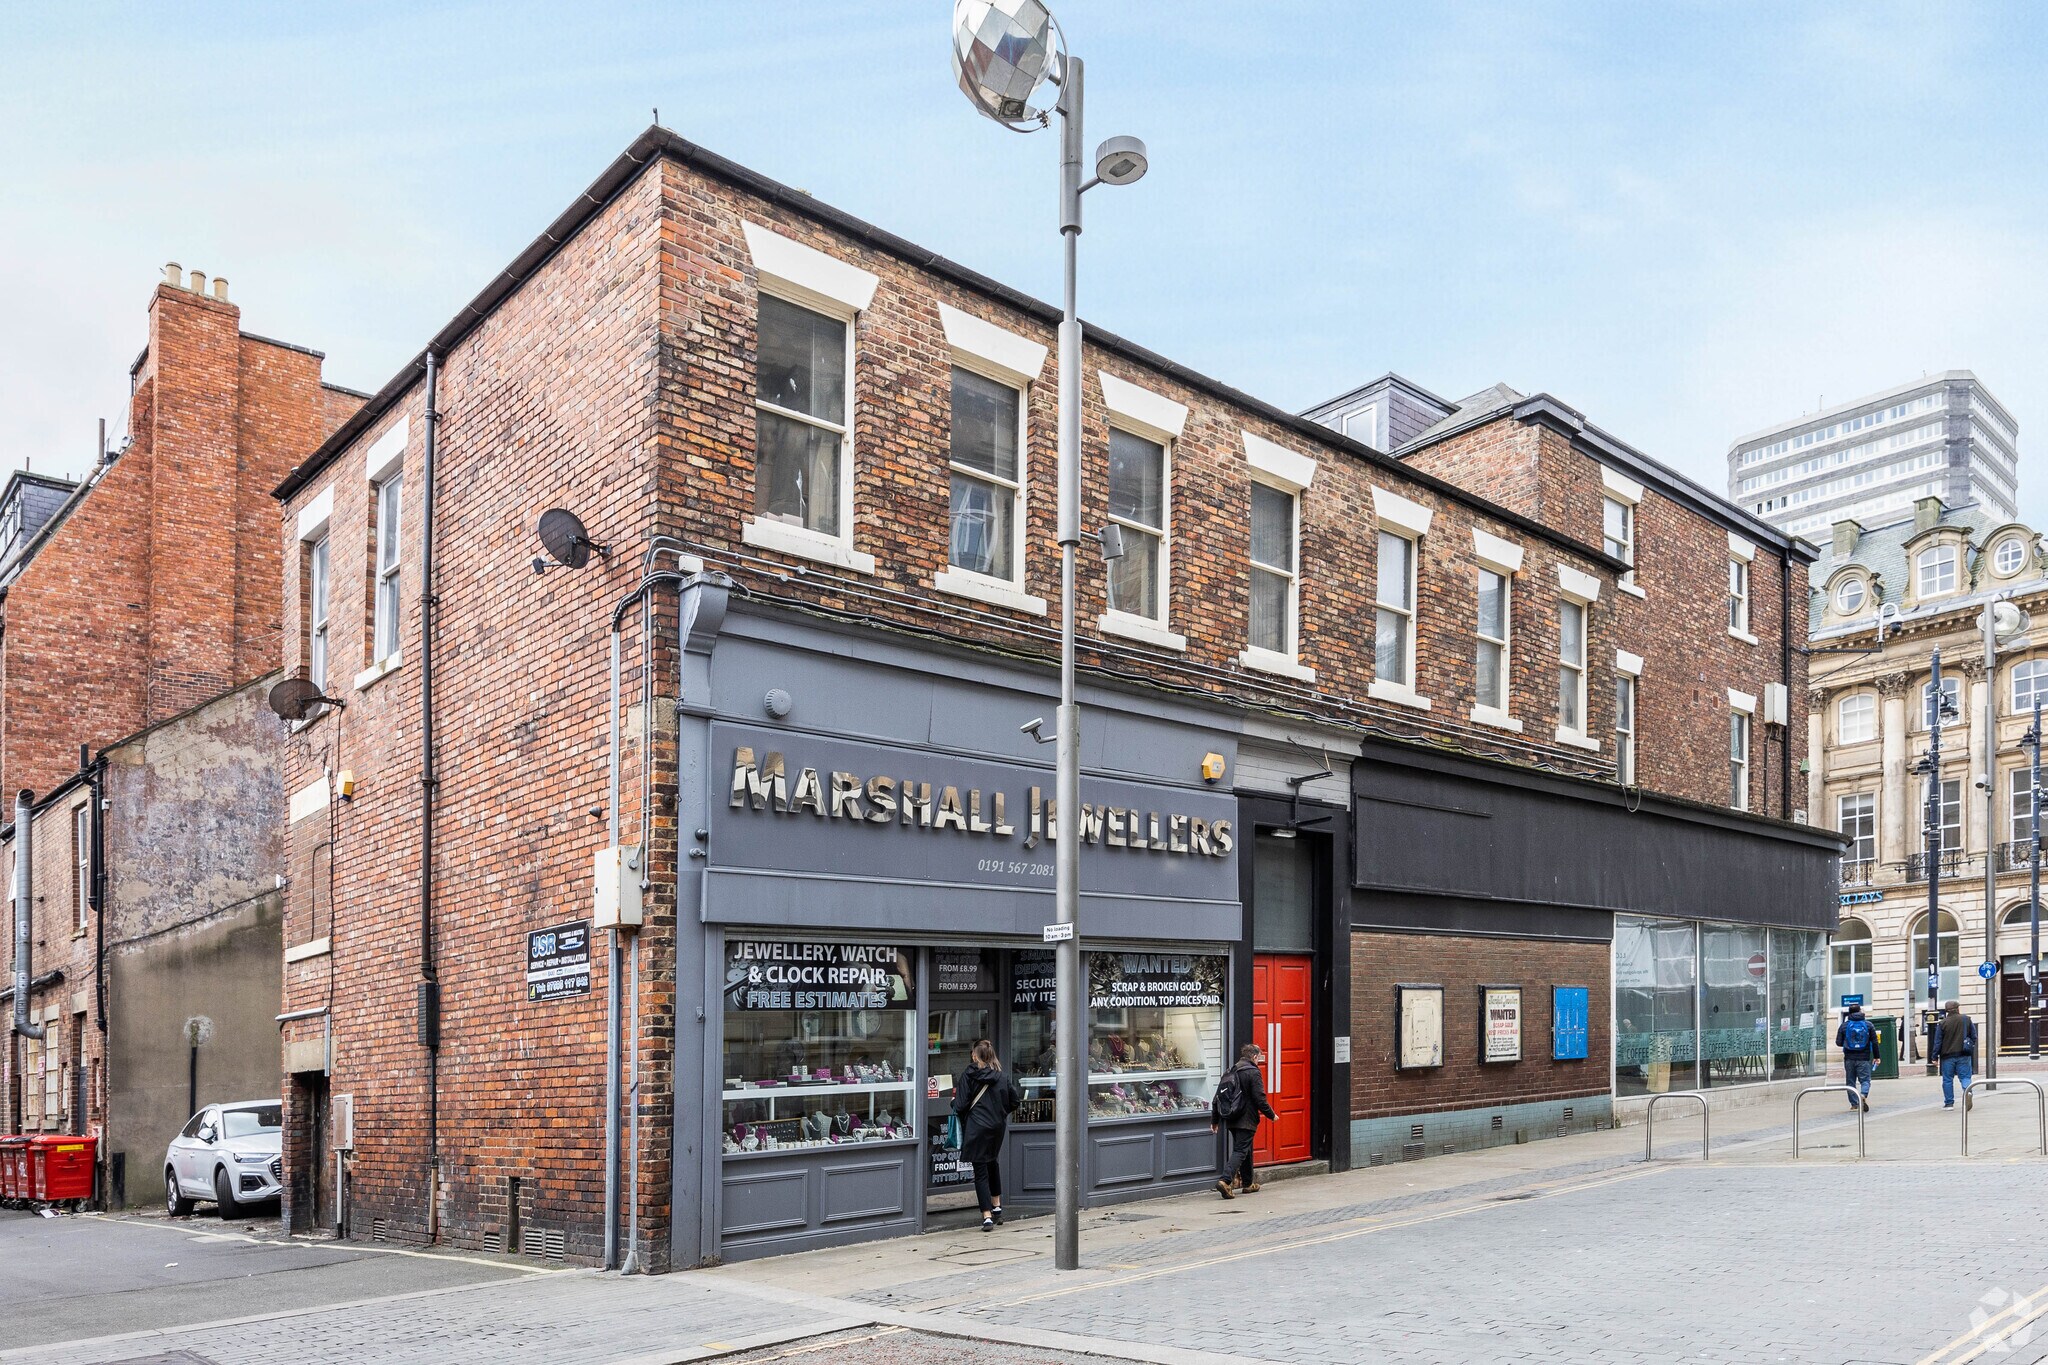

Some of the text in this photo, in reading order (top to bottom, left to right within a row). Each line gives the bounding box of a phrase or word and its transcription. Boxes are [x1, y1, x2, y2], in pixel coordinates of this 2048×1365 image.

[729, 747, 1016, 836] MARSHALL
[978, 859, 1055, 877] 0191 567 2081
[1839, 891, 1883, 905] RCLAYS
[532, 933, 556, 958] JSR
[734, 942, 897, 964] JEWELLERY, WATCH
[1021, 950, 1056, 961] SMAL
[531, 960, 544, 969] SERVICE
[546, 958, 558, 967] REPAIR
[939, 964, 959, 972] FROM
[1015, 963, 1056, 976] DEPOS
[1122, 954, 1192, 974] WANTED
[749, 965, 762, 983] &
[766, 966, 825, 984] CLOCK
[1016, 978, 1056, 990] SECURE
[1112, 981, 1201, 992] SCRAP & BROKEN GOLD
[747, 991, 888, 1008] FREE ESTIMATES
[1014, 991, 1056, 1003] ANY ITE
[1091, 995, 1220, 1007] ANY CONDITION, TOP PRICES PAID
[1490, 1009, 1516, 1020] WANTED
[1709, 1042, 1728, 1053] COFFEE
[1744, 1040, 1761, 1051] COFFEE
[1777, 1038, 1793, 1048] COFFEE
[1626, 1047, 1649, 1060] COFFEE
[1669, 1044, 1690, 1056] COFFEE
[932, 1153, 947, 1162] TOP
[934, 1162, 955, 1171] FROM
[932, 1170, 975, 1183] FITTED FRE
